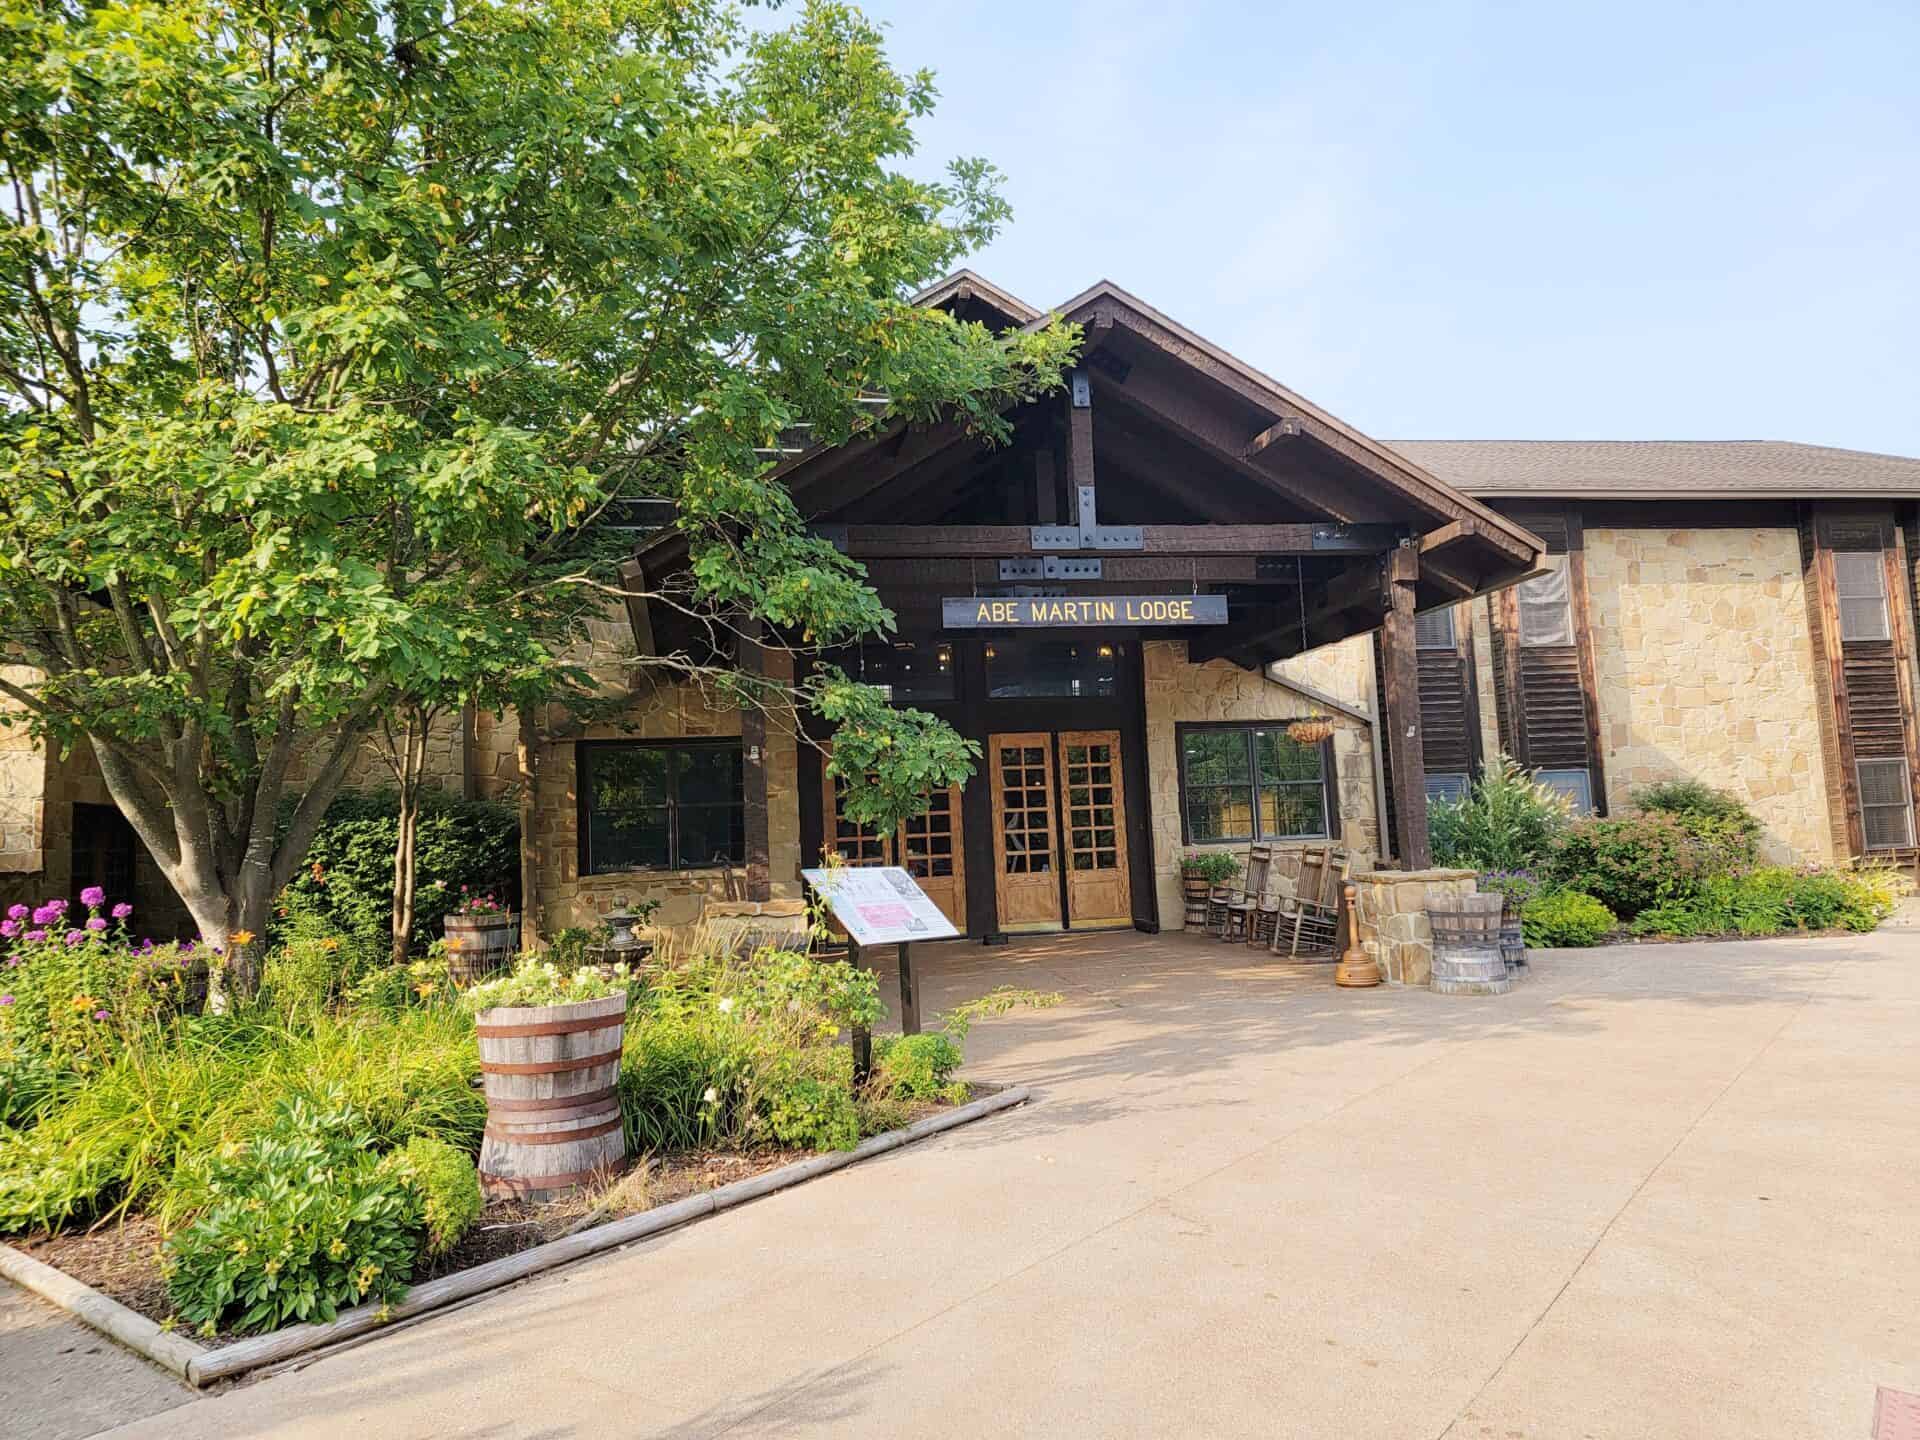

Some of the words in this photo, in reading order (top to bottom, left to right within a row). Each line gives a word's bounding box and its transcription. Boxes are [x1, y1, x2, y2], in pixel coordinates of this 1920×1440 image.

[976, 602, 1019, 622] ABE
[1032, 601, 1115, 622] MARTIN
[1127, 600, 1195, 621] LODGE
